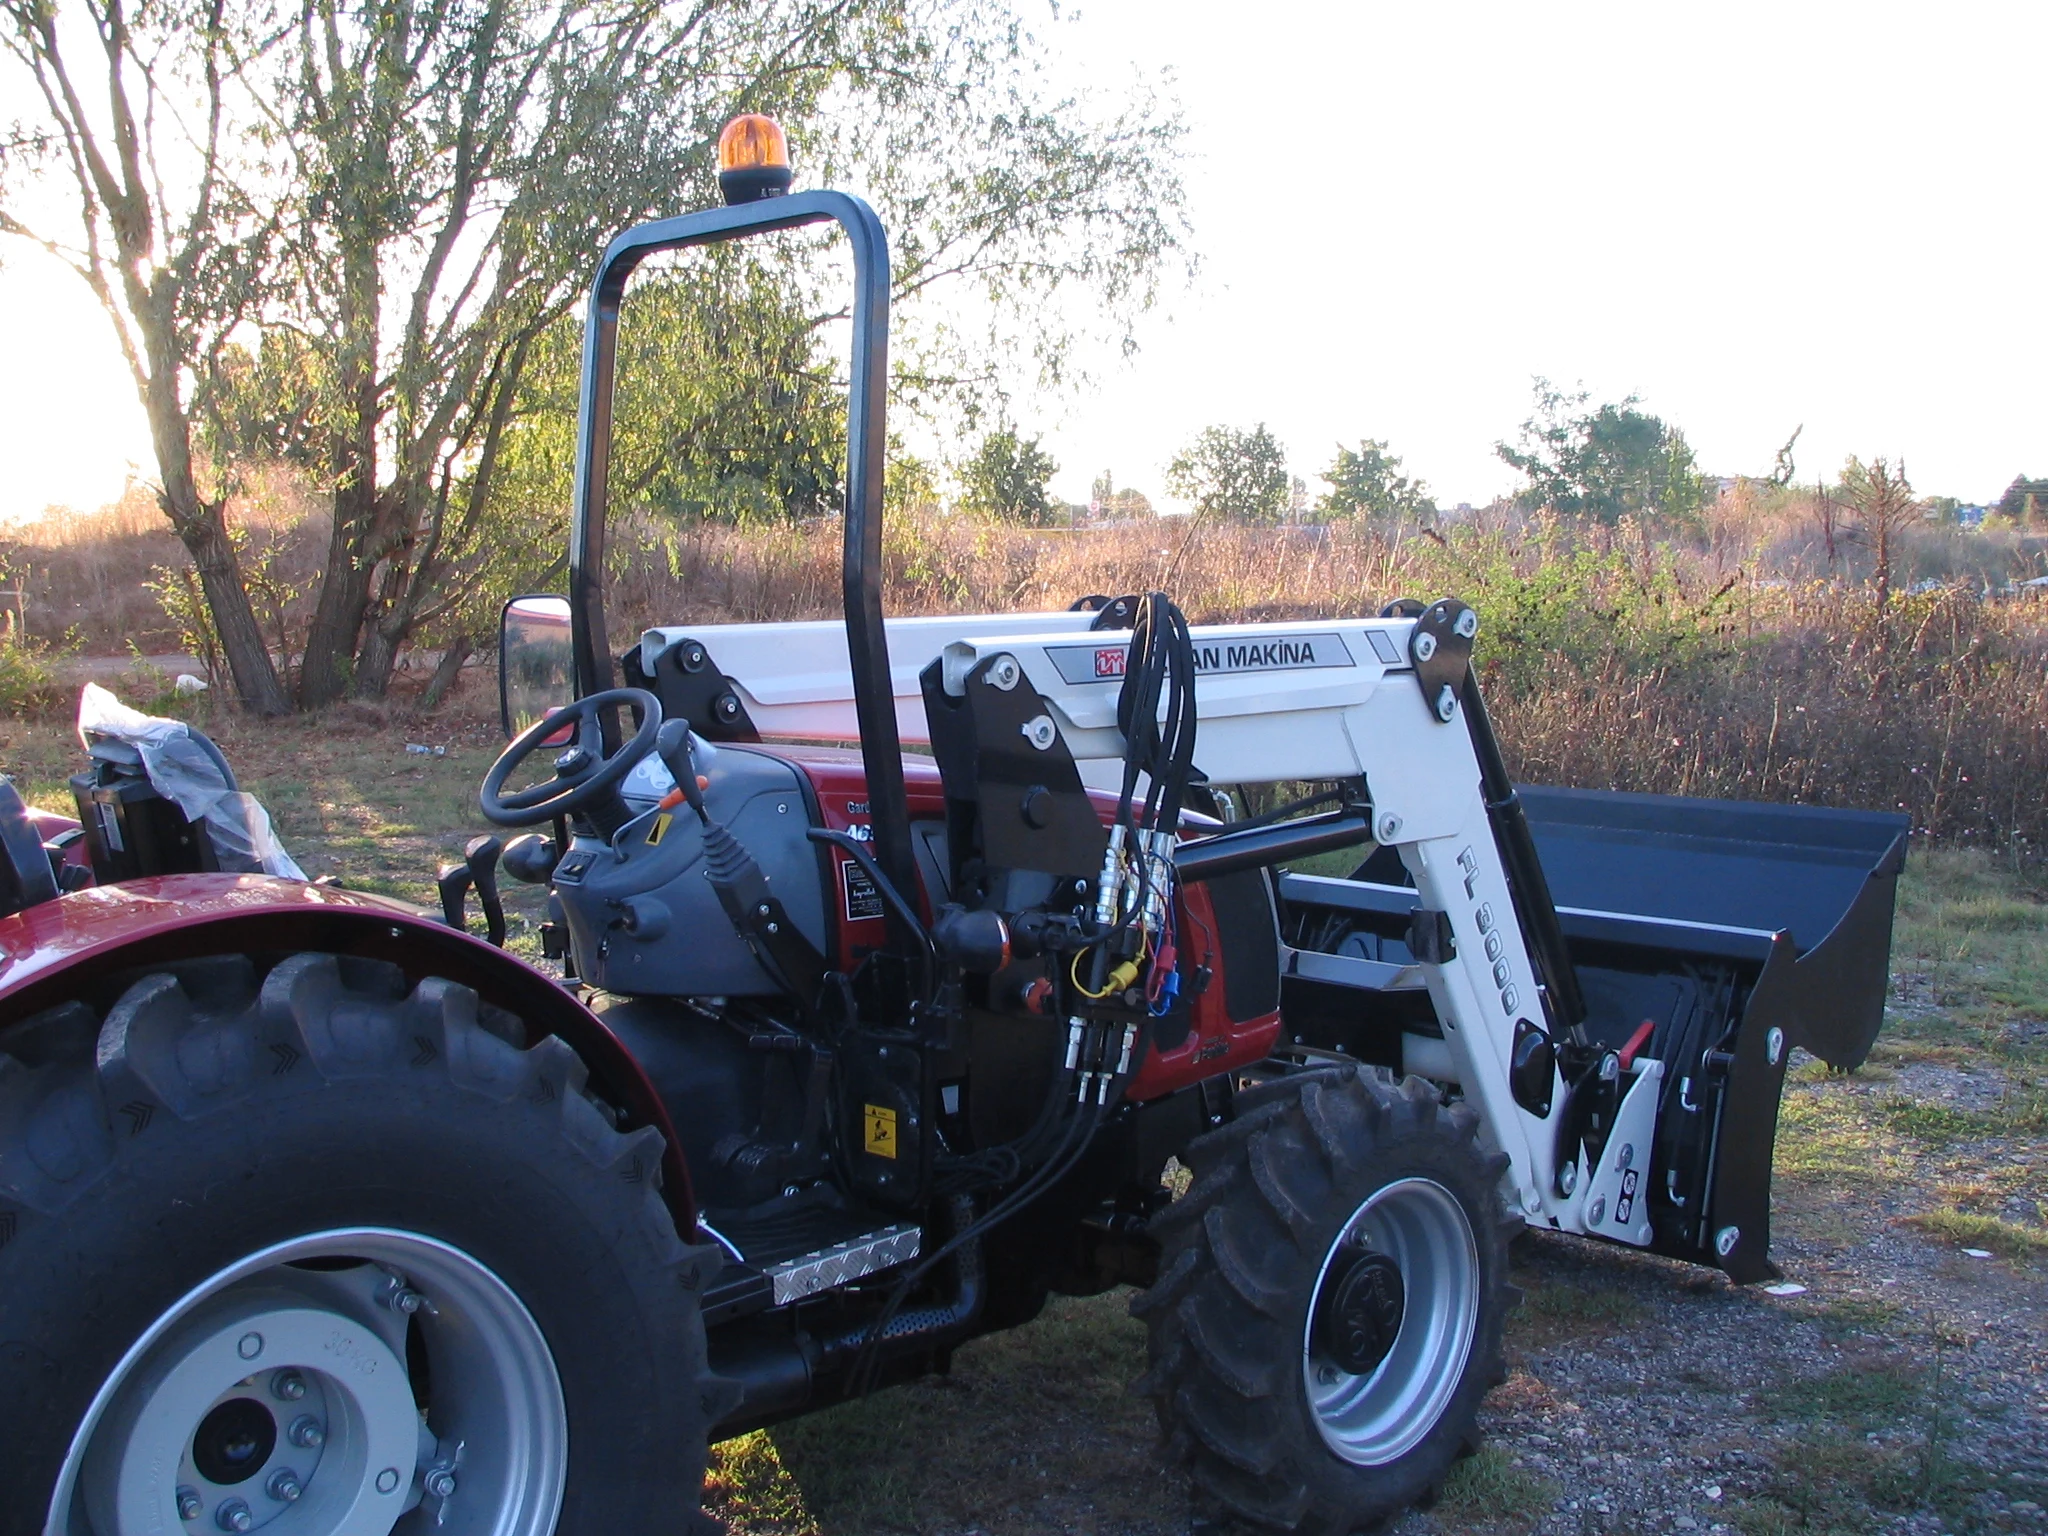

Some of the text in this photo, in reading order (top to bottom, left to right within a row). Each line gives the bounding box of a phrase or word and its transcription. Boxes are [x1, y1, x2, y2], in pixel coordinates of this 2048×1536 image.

[1227, 639, 1316, 669] MAKİNA
[847, 800, 871, 814] Gard
[847, 824, 875, 841] 46
[1456, 845, 1520, 1016] FL 3000
